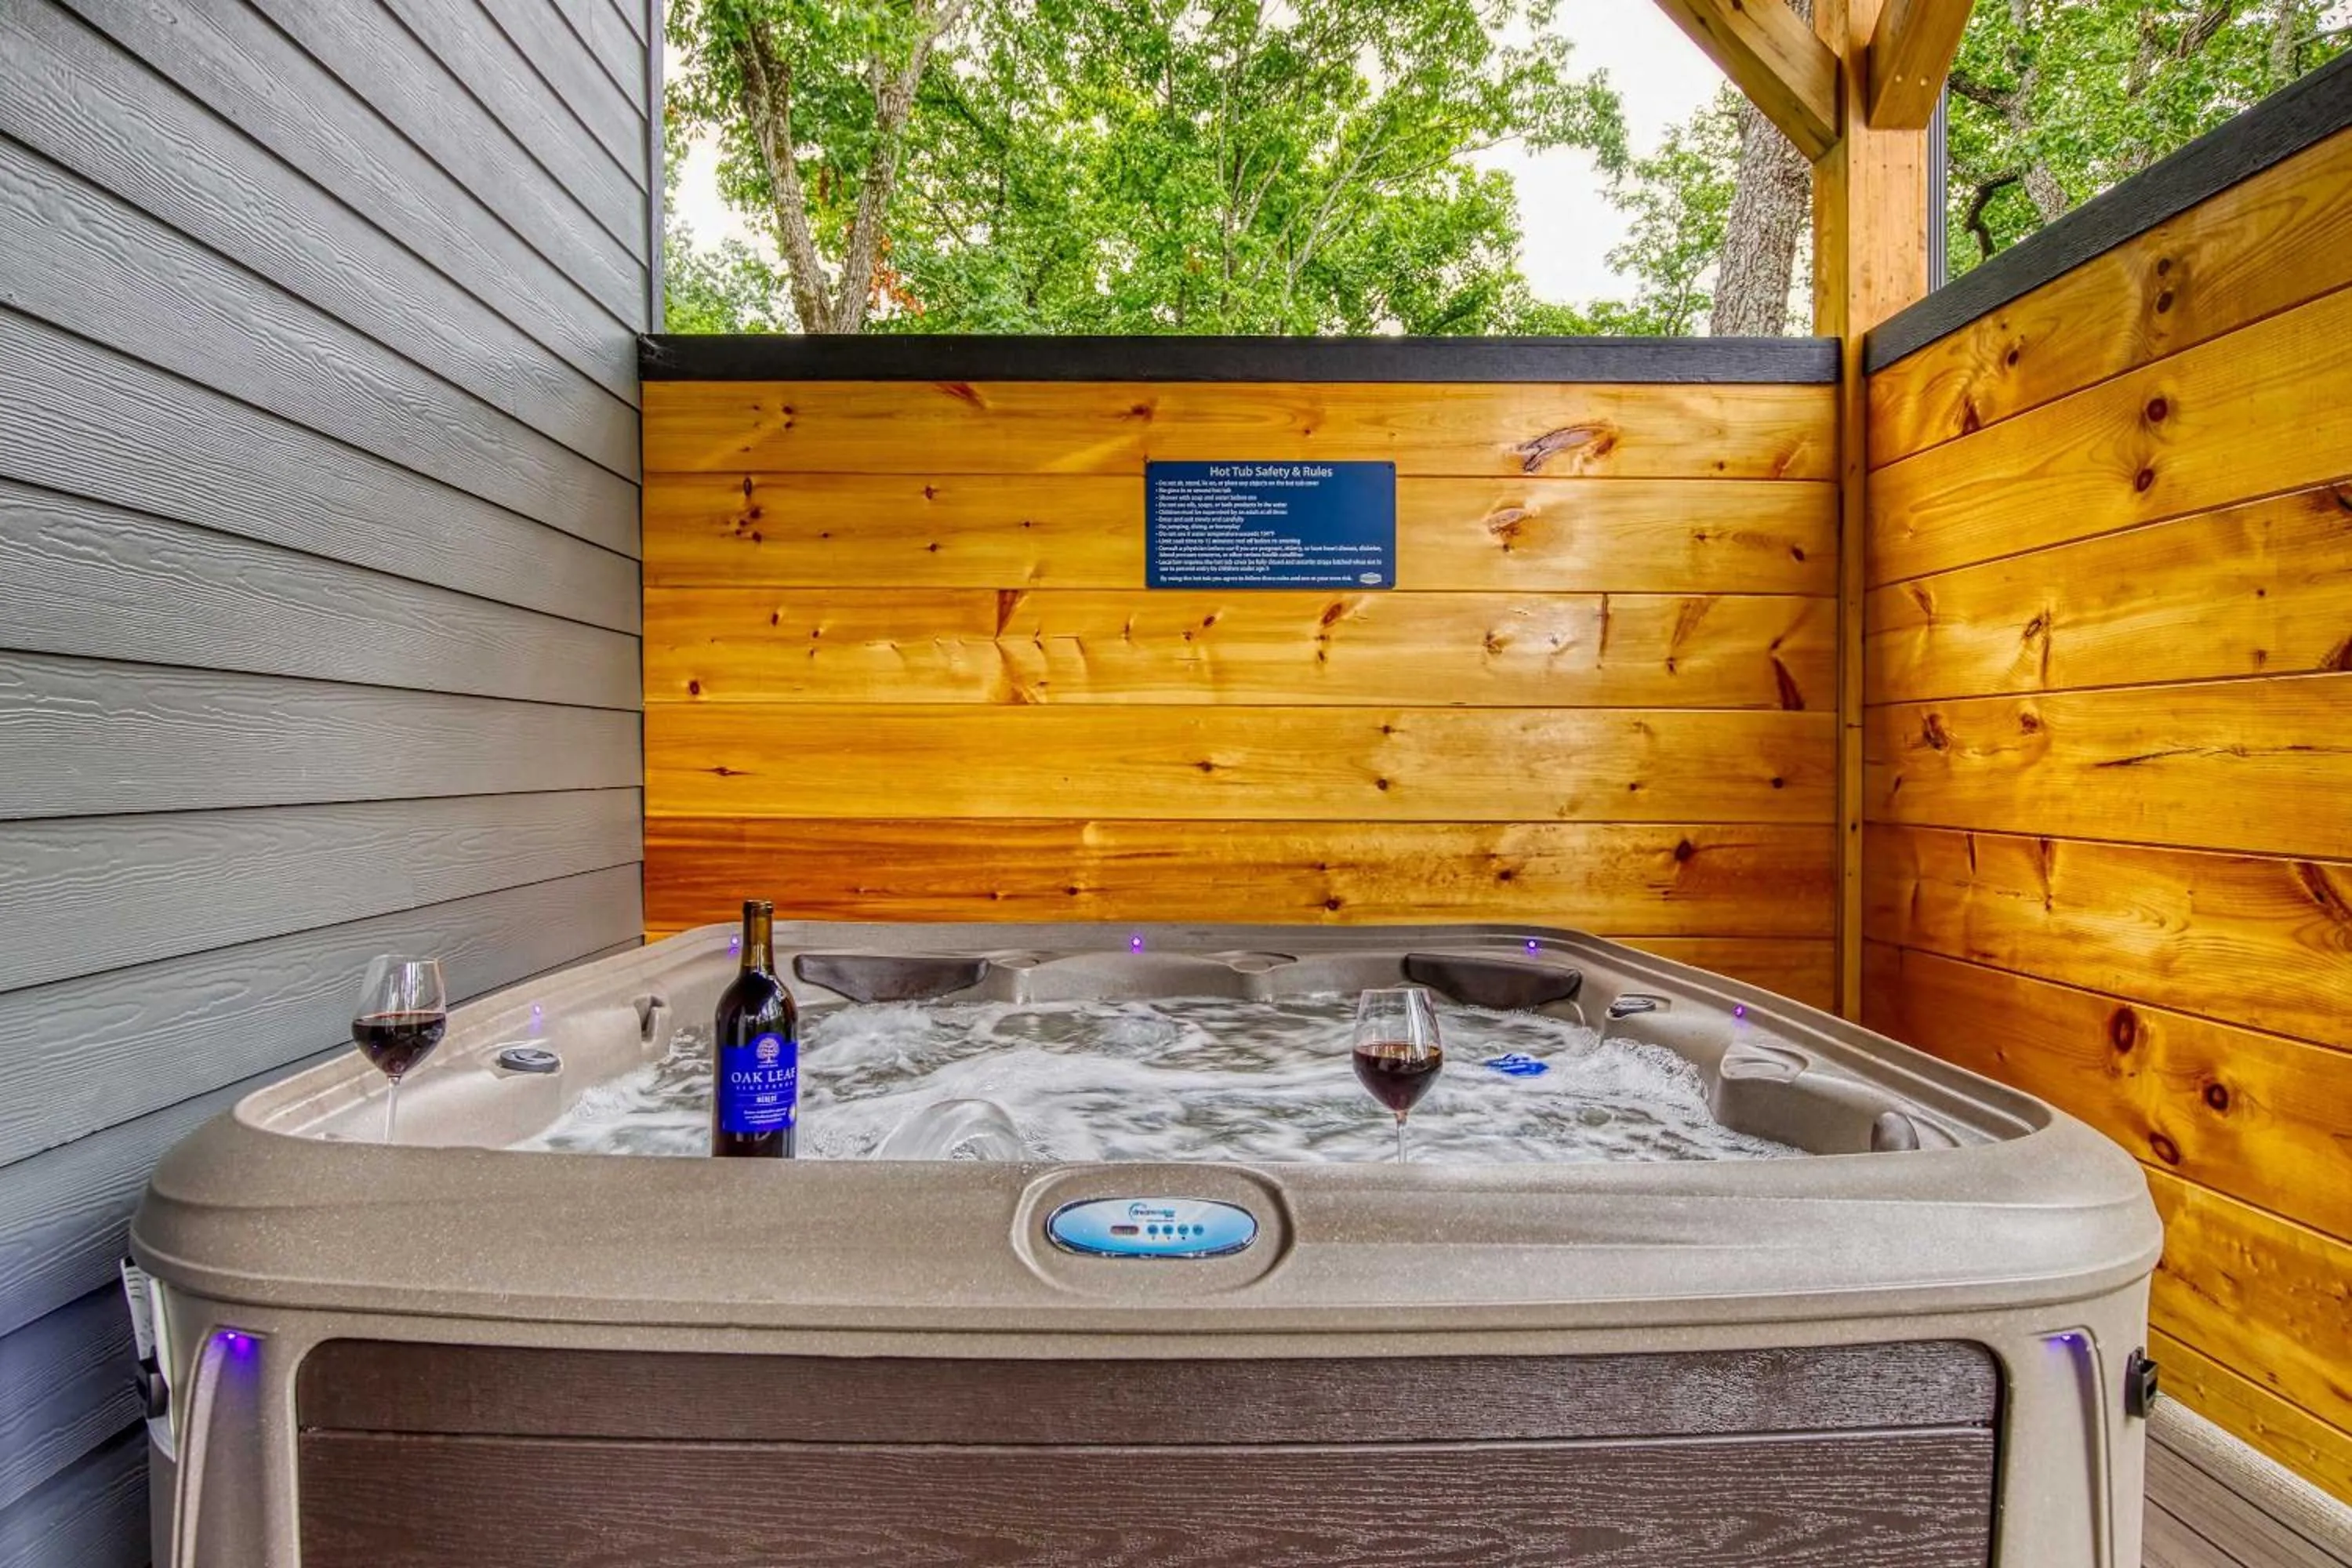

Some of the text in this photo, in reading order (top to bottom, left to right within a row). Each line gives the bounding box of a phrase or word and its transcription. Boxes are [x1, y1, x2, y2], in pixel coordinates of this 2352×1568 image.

[1210, 466, 1334, 479] Hot Tub Safety & Rules
[731, 1067, 797, 1083] OAK LEAF
